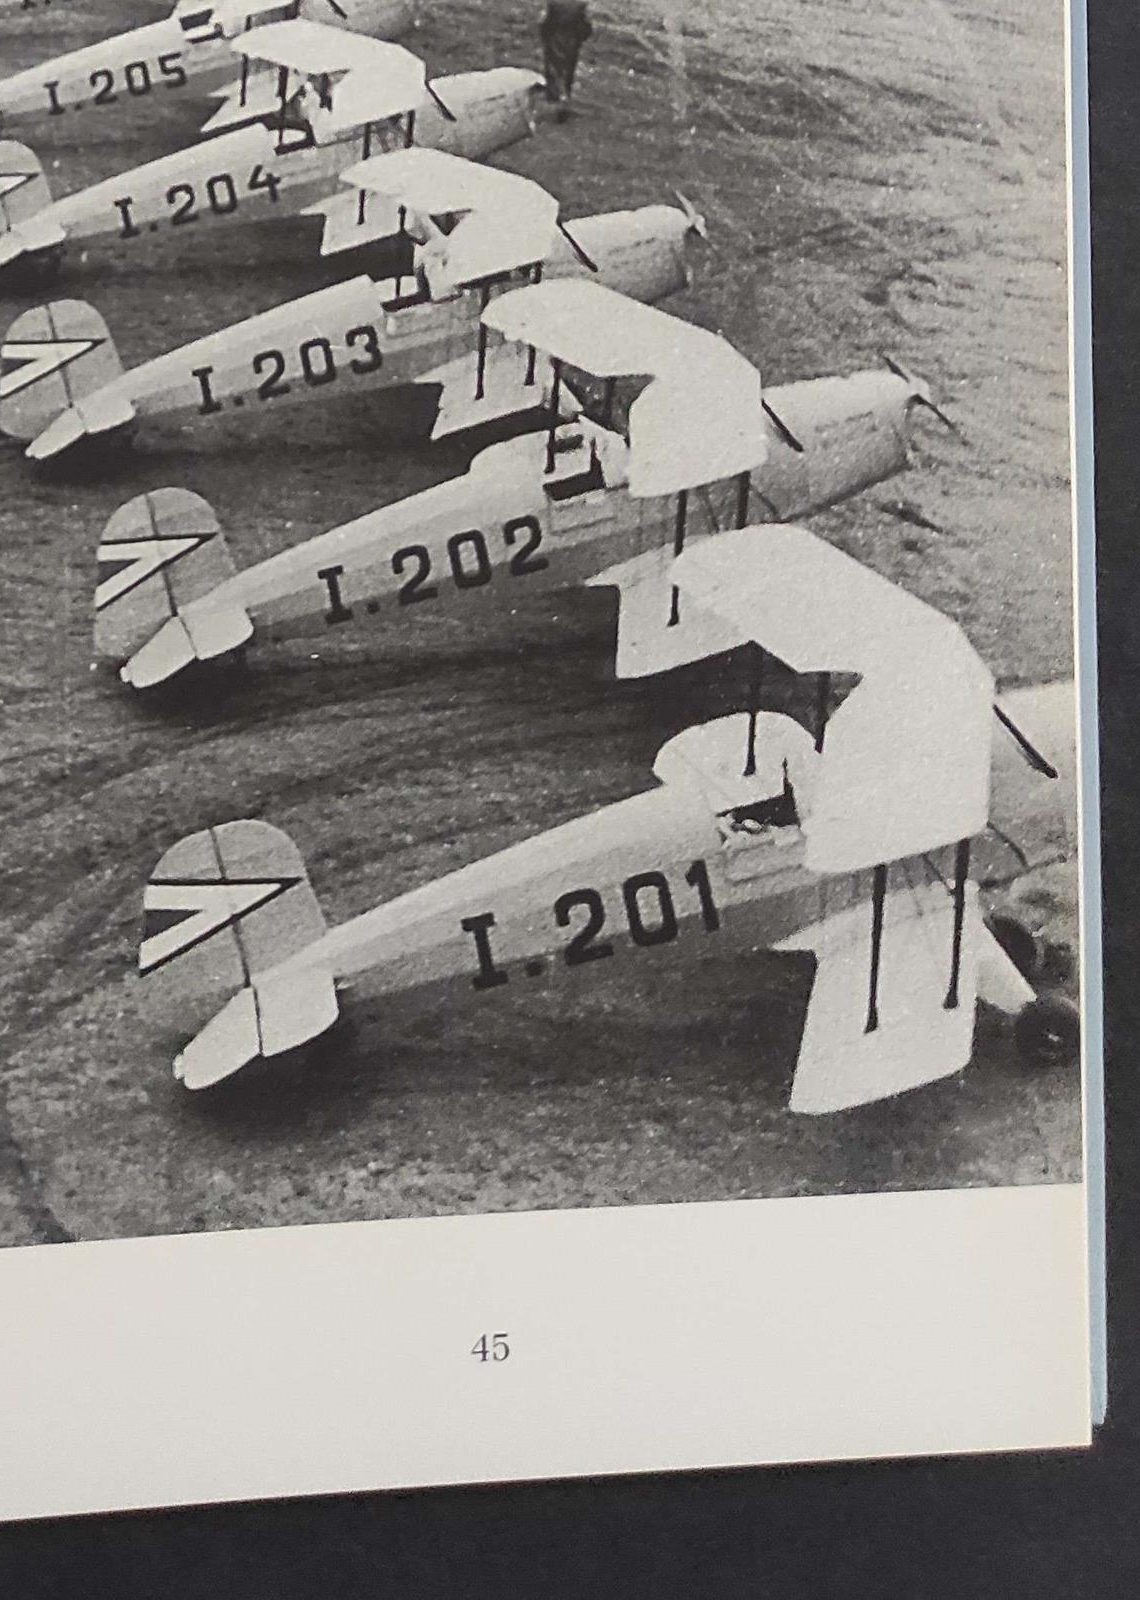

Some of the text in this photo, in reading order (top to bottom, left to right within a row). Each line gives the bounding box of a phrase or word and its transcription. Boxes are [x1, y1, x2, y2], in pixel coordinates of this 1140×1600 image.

[43, 52, 189, 116] I.205
[114, 165, 281, 239] I.204
[192, 325, 384, 415] I.203
[317, 515, 550, 625] I.202
[461, 859, 721, 990] I.201
[471, 1333, 510, 1362] 45
